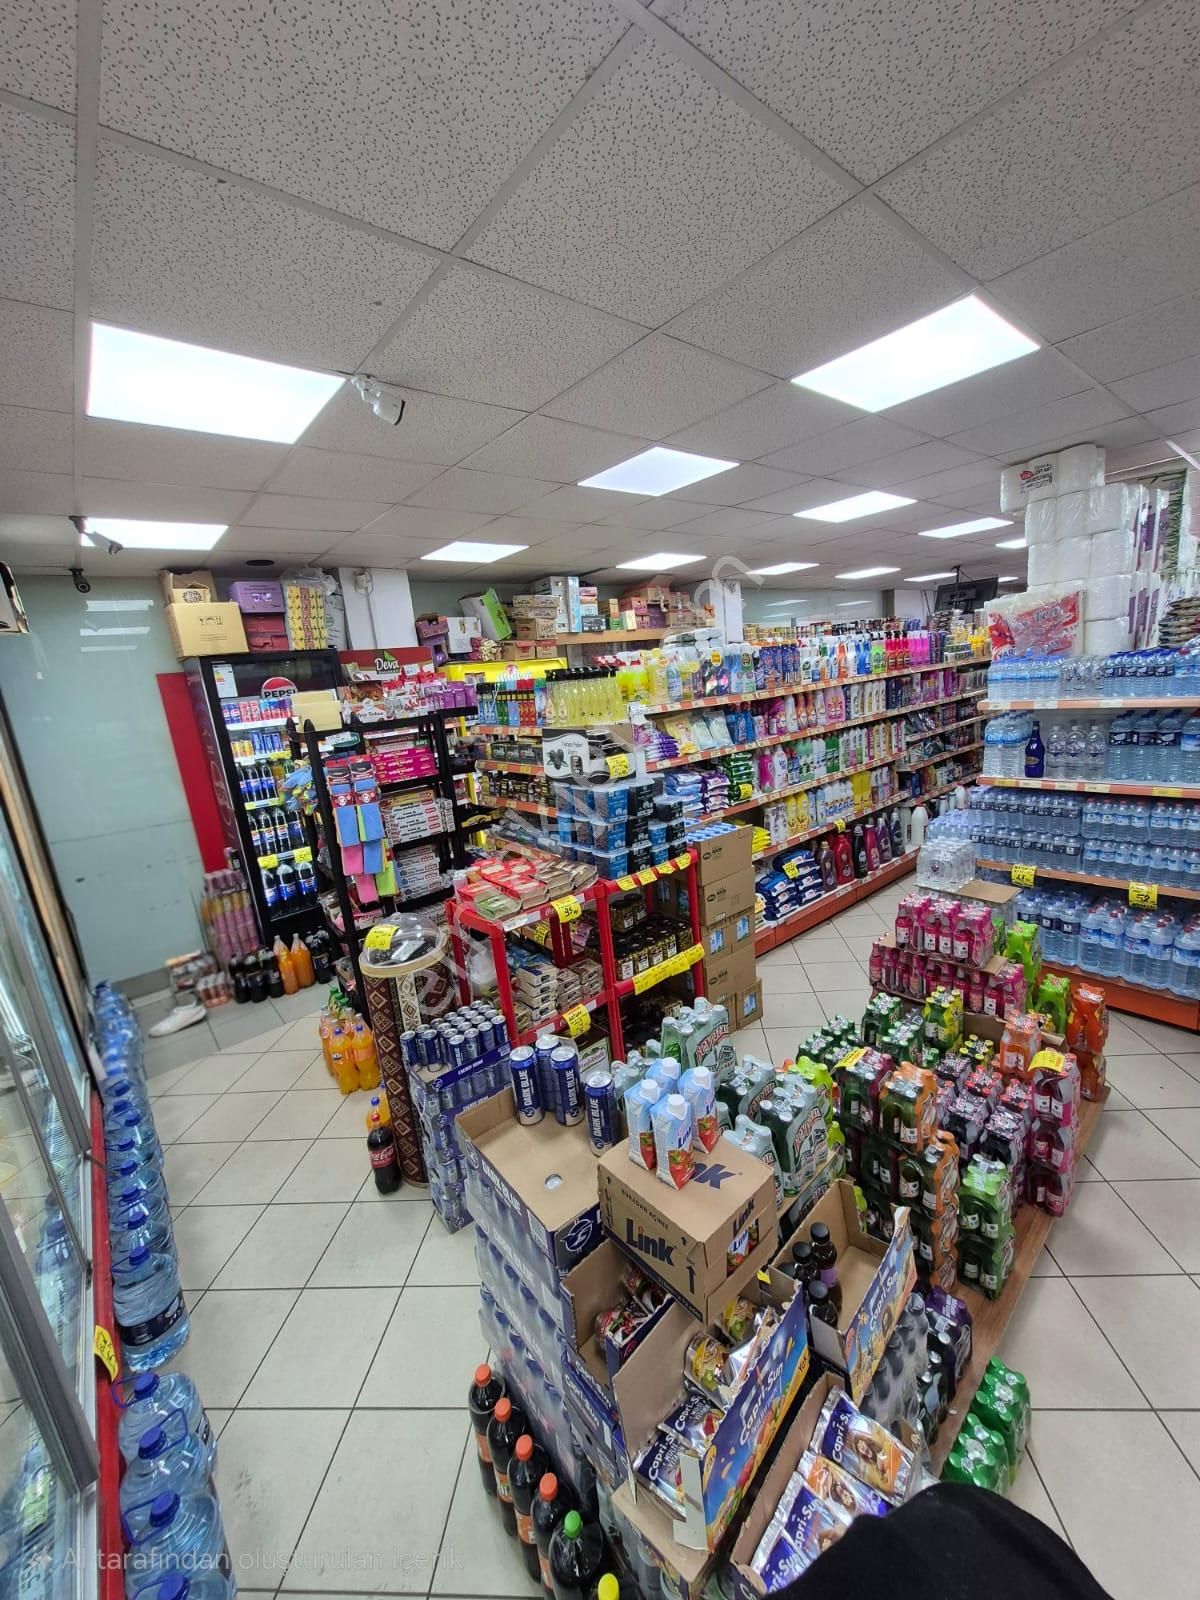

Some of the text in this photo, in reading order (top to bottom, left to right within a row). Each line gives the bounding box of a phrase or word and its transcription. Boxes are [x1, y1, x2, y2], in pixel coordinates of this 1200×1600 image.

[375, 657, 400, 671] Deva
[519, 1069, 533, 1107] DARK BLUE
[565, 1069, 578, 1106] DARK BLUE
[589, 1098, 602, 1137] DARK BLUE
[481, 1159, 522, 1216] DARK BLUE
[733, 1198, 755, 1238] Link
[626, 1218, 675, 1267] Link
[740, 1362, 784, 1446] Capri-Sun
[794, 1498, 824, 1552] apri-Sun
